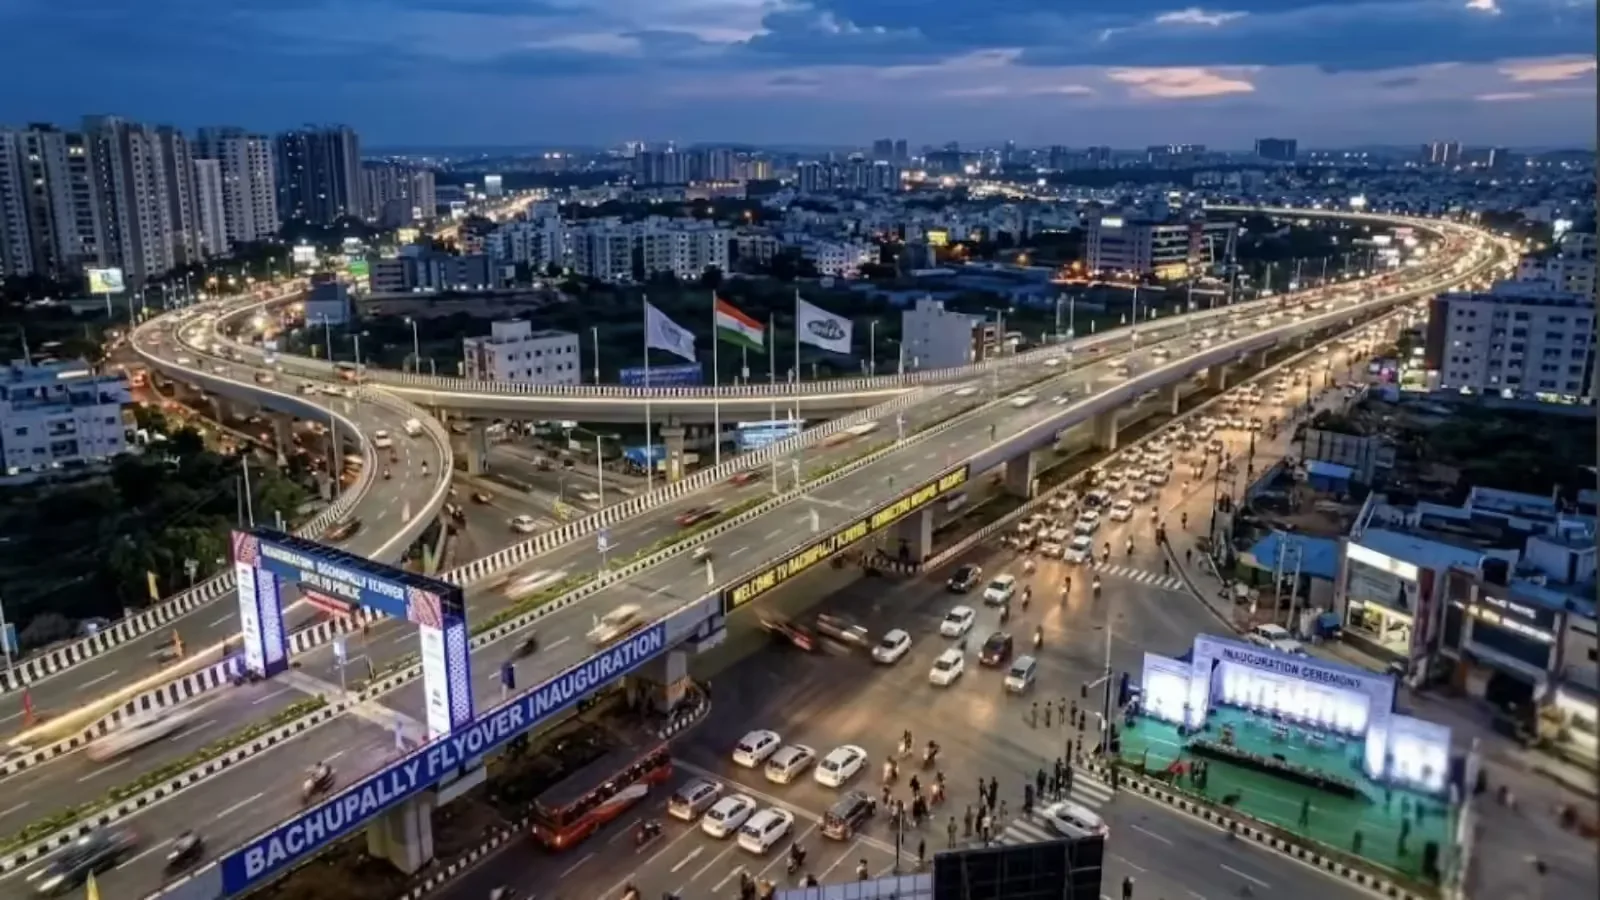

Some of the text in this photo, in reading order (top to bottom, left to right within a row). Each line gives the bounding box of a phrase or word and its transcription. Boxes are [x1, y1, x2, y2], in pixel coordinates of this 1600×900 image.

[733, 571, 775, 606] WELCOME
[1222, 647, 1362, 689] INAUGURATION CEREMONY
[244, 627, 663, 880] BACHUPALLY FLYOVER INAUGURATION
